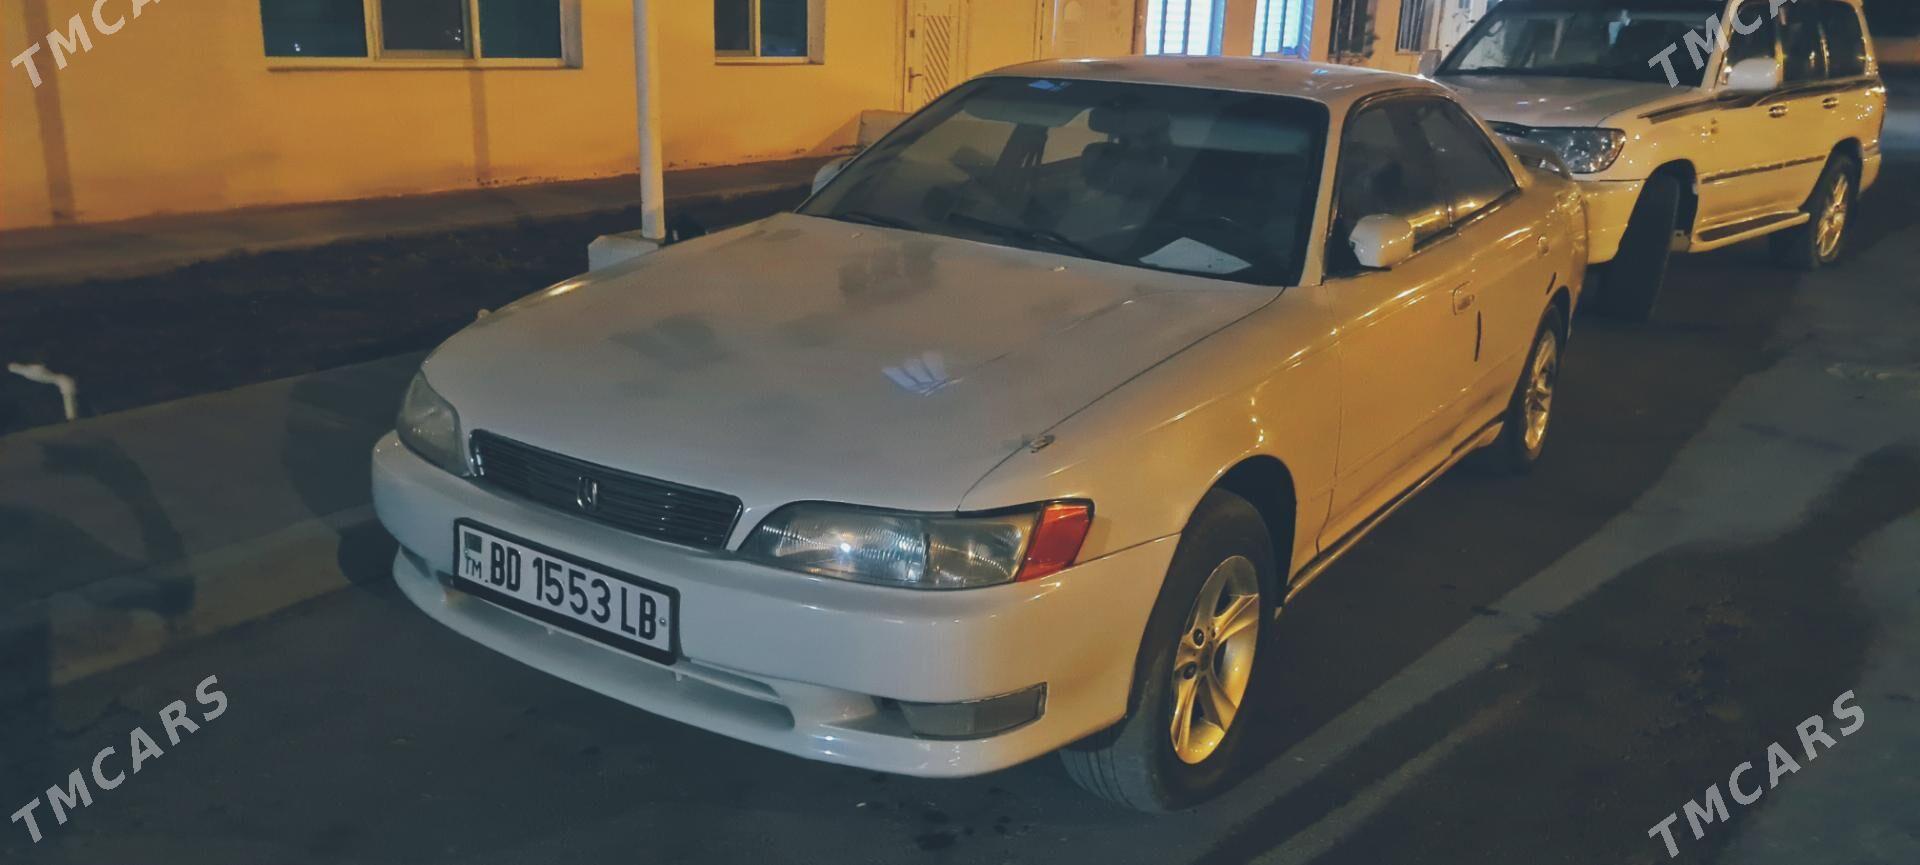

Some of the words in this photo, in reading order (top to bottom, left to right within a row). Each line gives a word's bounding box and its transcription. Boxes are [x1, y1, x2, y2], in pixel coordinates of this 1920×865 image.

[490, 541, 521, 592] BD
[532, 557, 612, 624] 1553
[620, 586, 657, 640] LB
